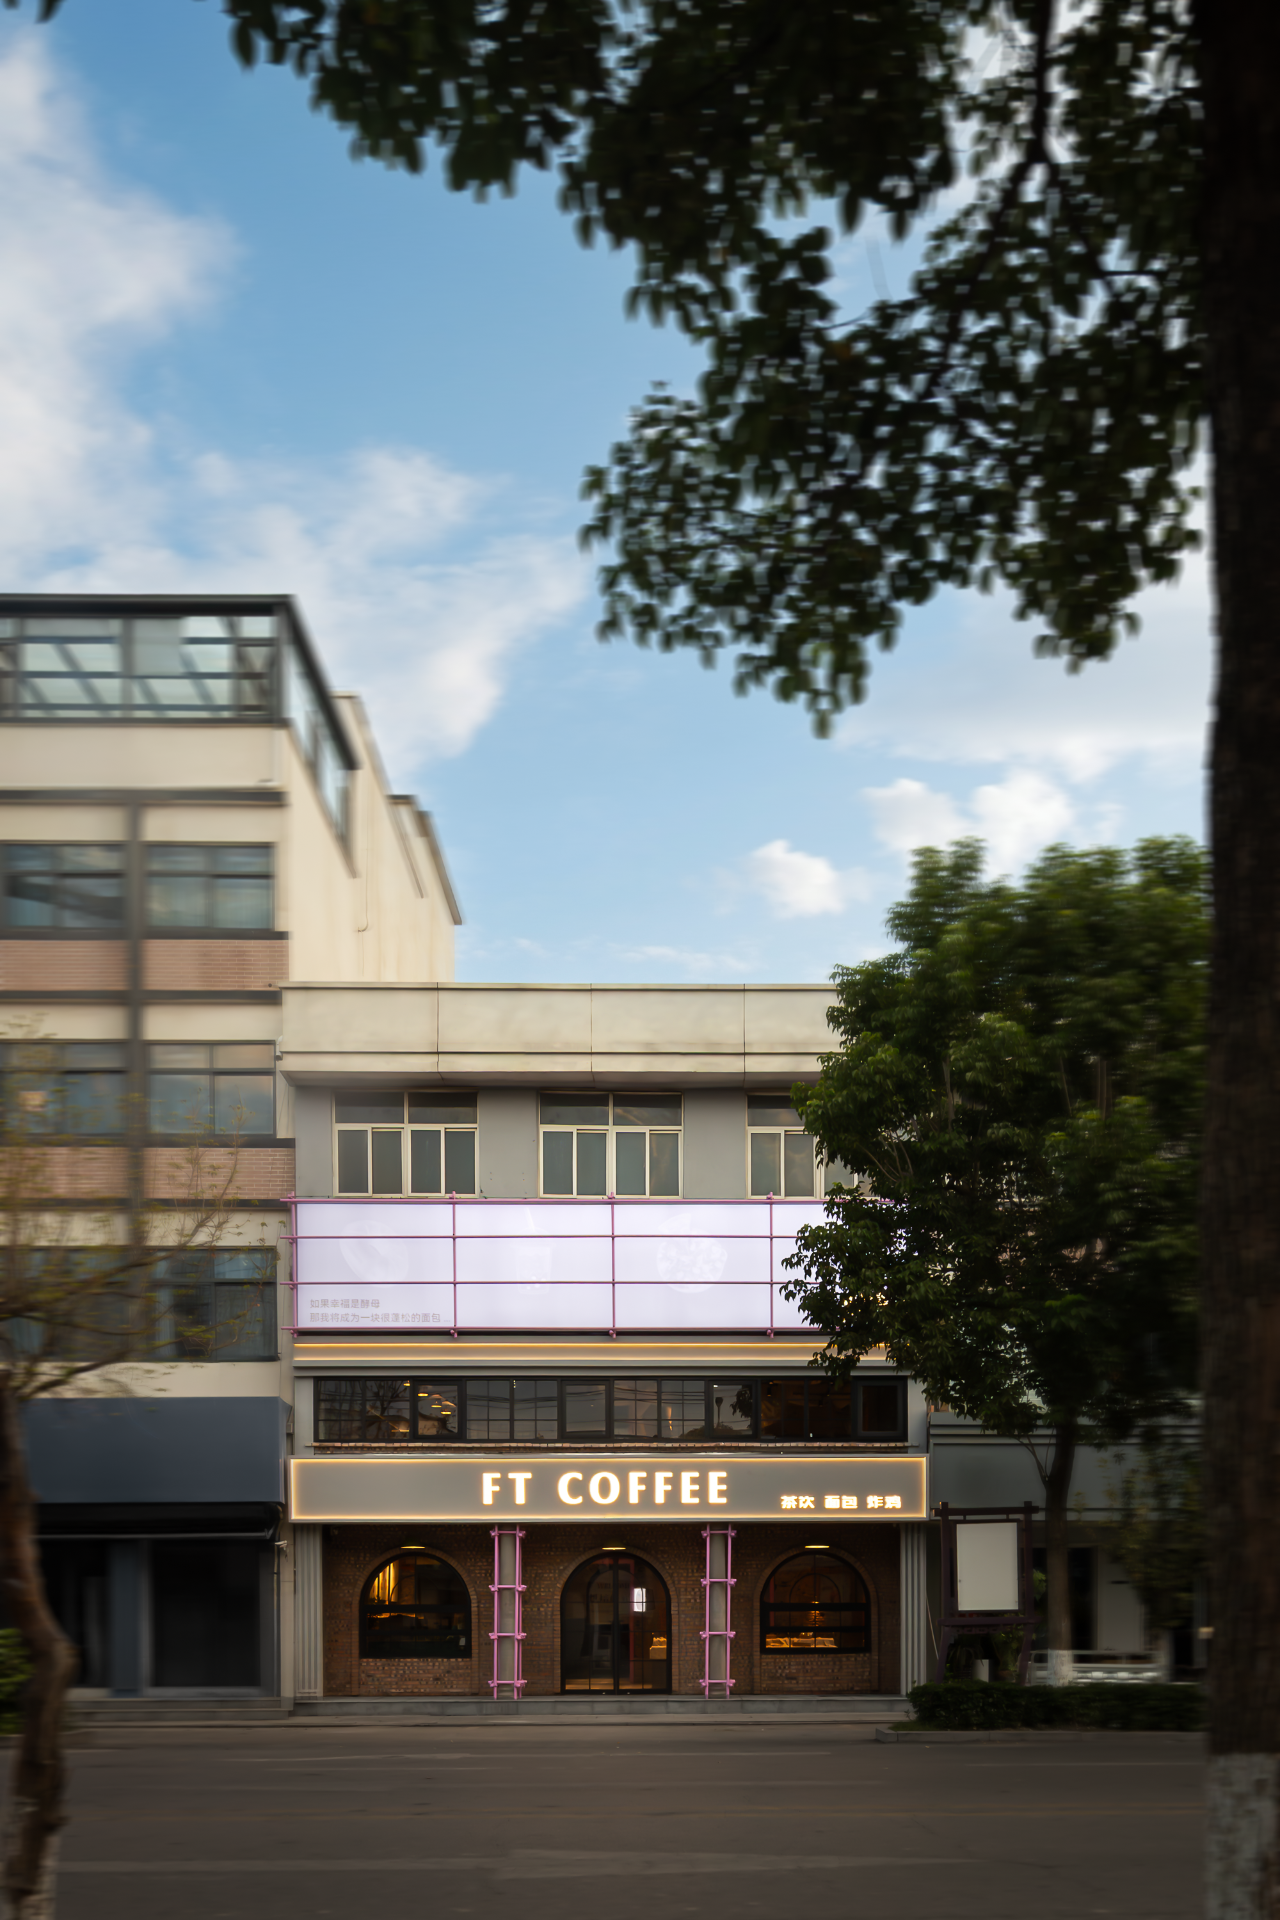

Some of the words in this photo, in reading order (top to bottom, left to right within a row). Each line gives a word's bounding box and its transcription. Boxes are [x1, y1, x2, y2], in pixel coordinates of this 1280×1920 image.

[310, 1298, 380, 1309] 如果幸福是酵母
[481, 1472, 533, 1505] FT
[556, 1471, 729, 1505] COFFEE
[780, 1494, 815, 1509] 茶饮
[824, 1494, 858, 1509] 面包
[866, 1494, 902, 1509] 炸鸡
